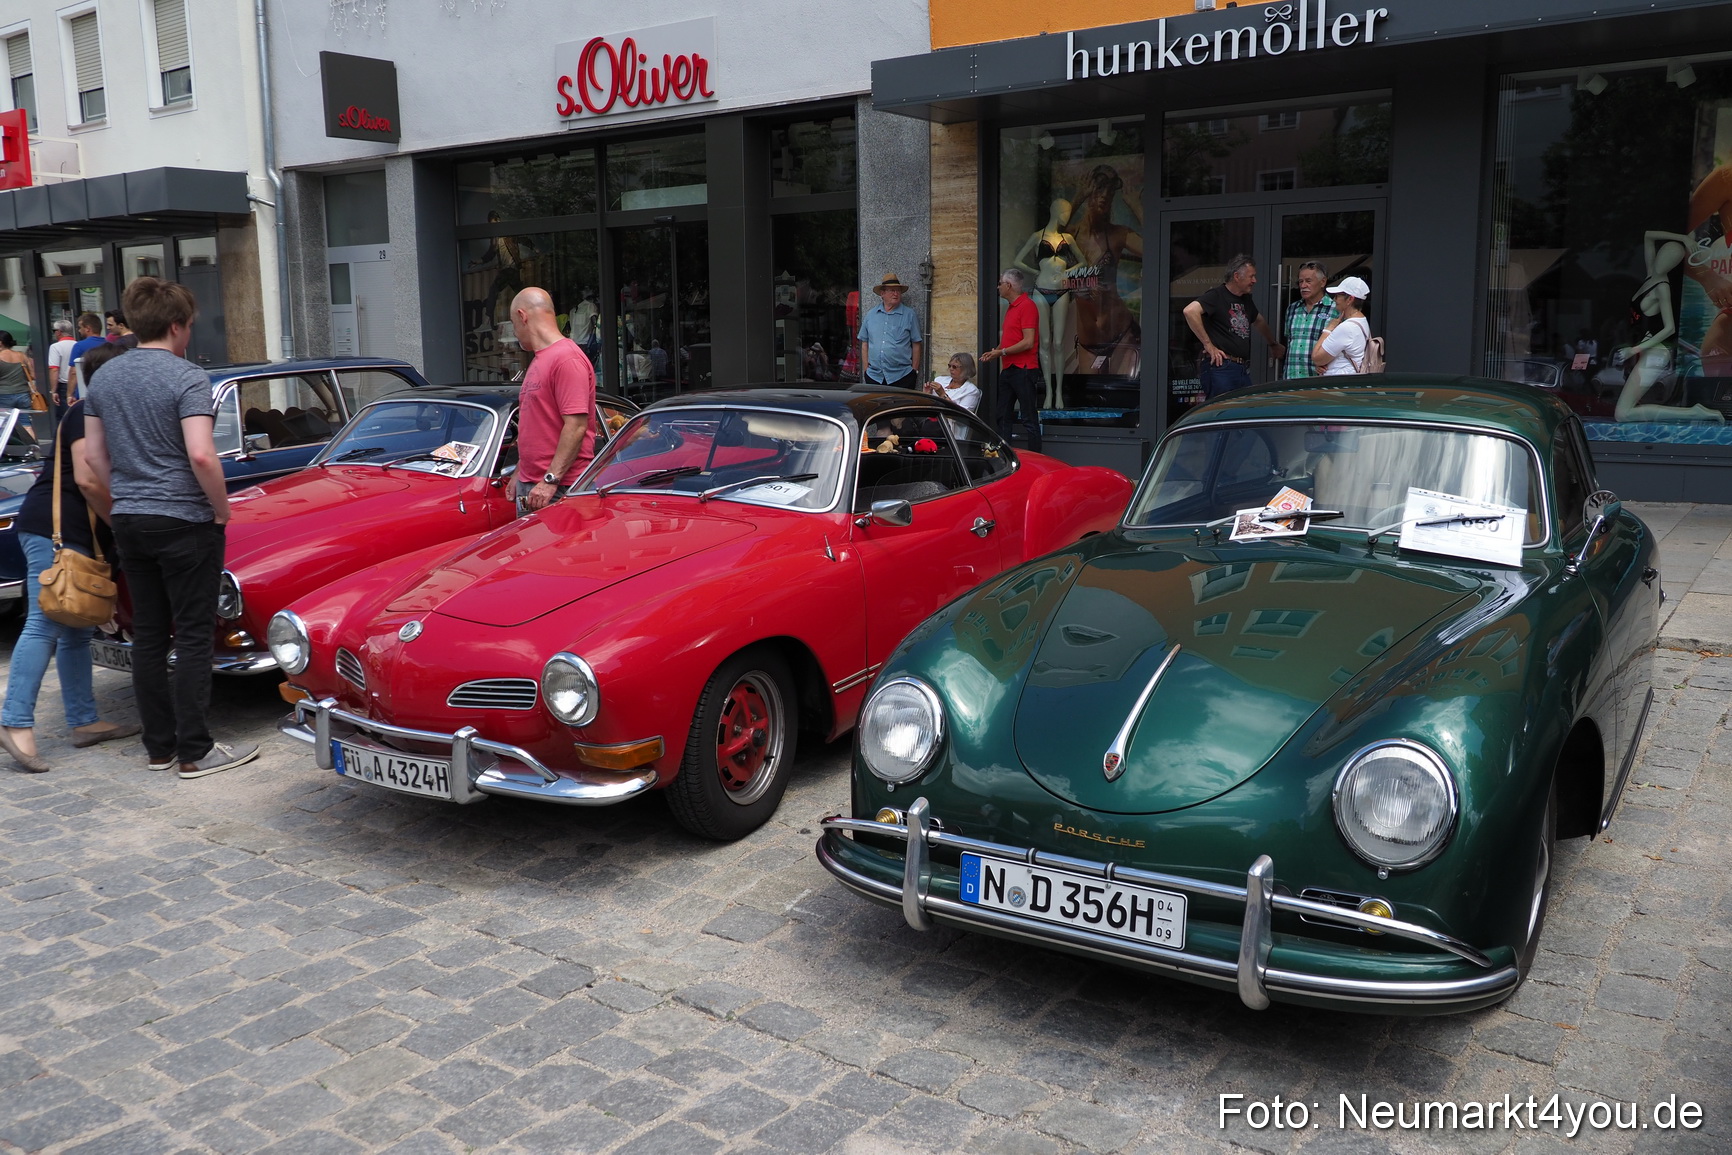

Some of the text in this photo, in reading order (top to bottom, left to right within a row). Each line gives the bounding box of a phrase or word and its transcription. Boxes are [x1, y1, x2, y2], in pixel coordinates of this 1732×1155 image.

[1066, 0, 1389, 80] hunkemöller
[556, 36, 715, 117] s.Oliver
[338, 105, 391, 132] s.Oliver
[379, 250, 386, 259] 29
[1053, 822, 1145, 848] PORSCHE
[984, 865, 1005, 903] N
